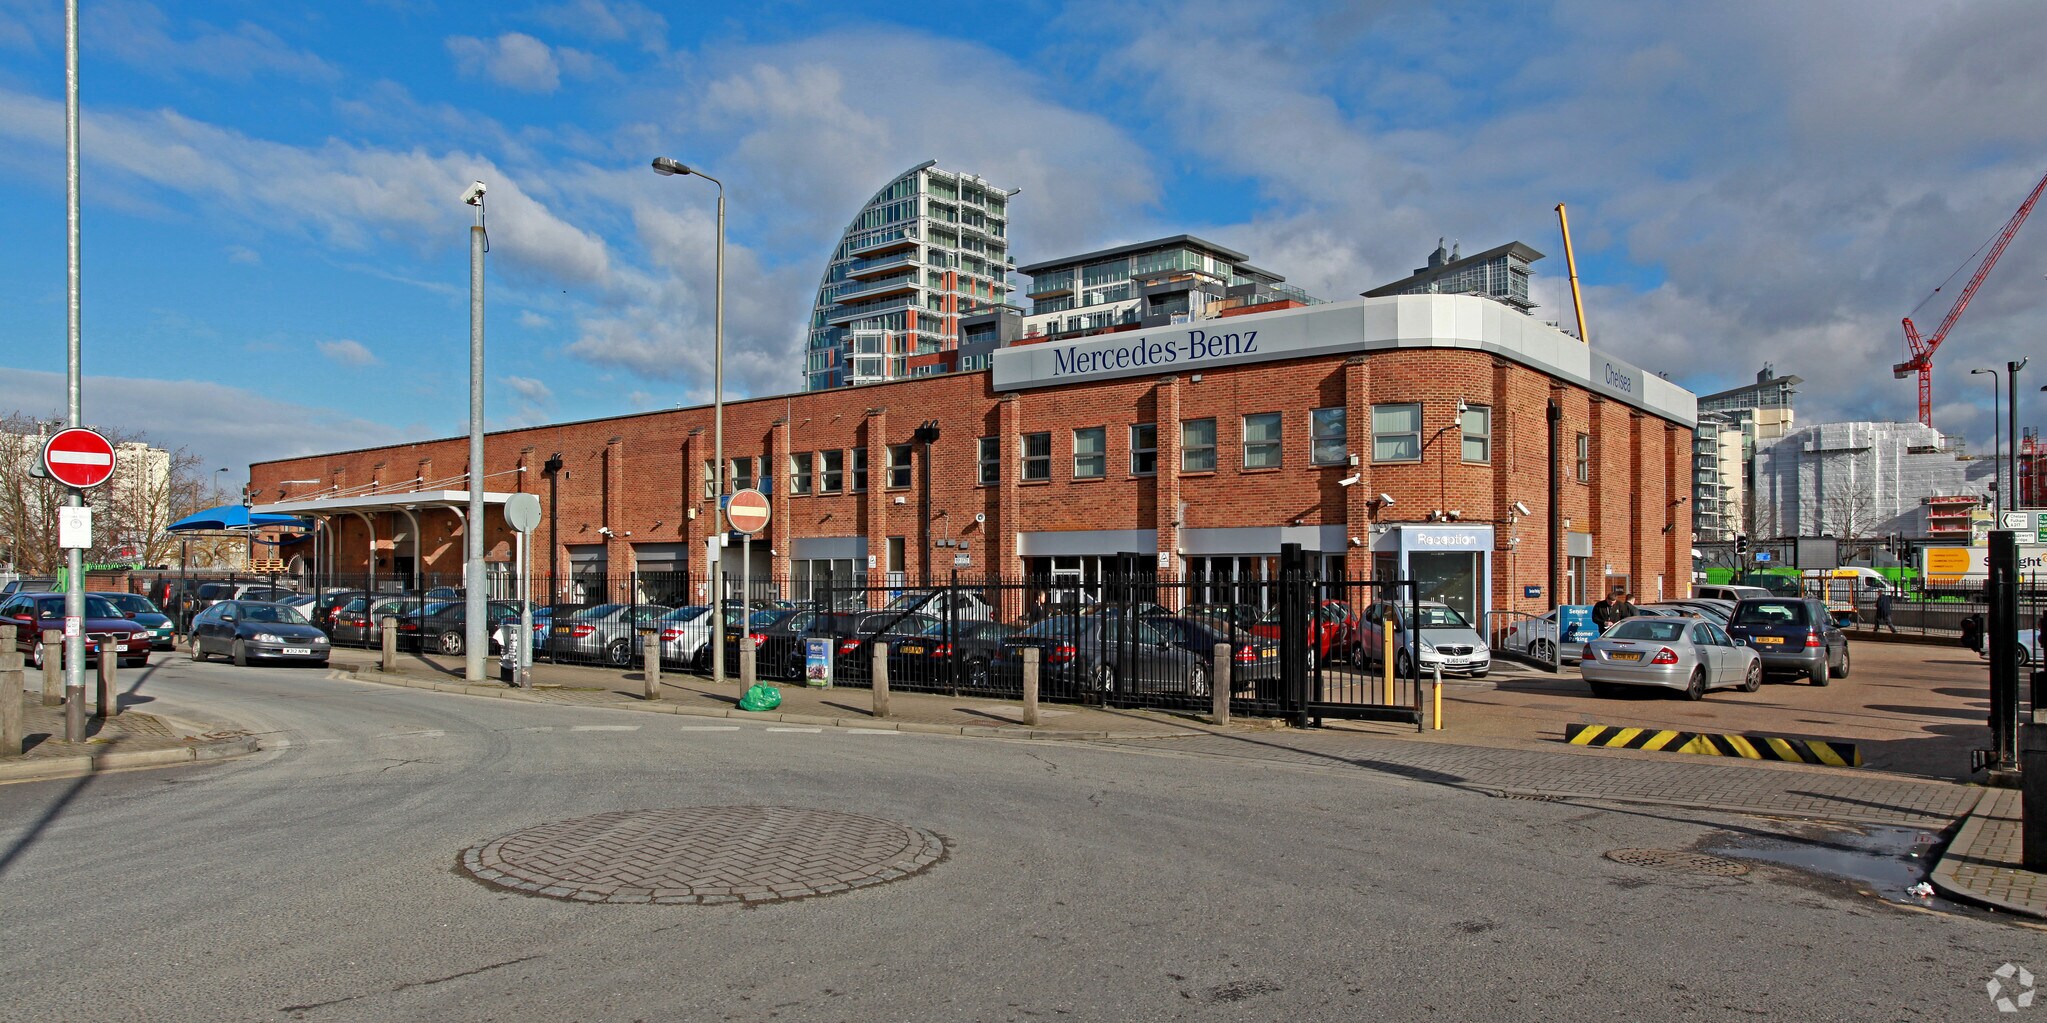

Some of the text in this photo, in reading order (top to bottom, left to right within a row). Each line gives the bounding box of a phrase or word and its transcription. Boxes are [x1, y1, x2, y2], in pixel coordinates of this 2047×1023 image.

[1052, 330, 1258, 376] Mercedes-Benz
[1605, 362, 1631, 393] Chelsea
[1417, 533, 1476, 547] Reception
